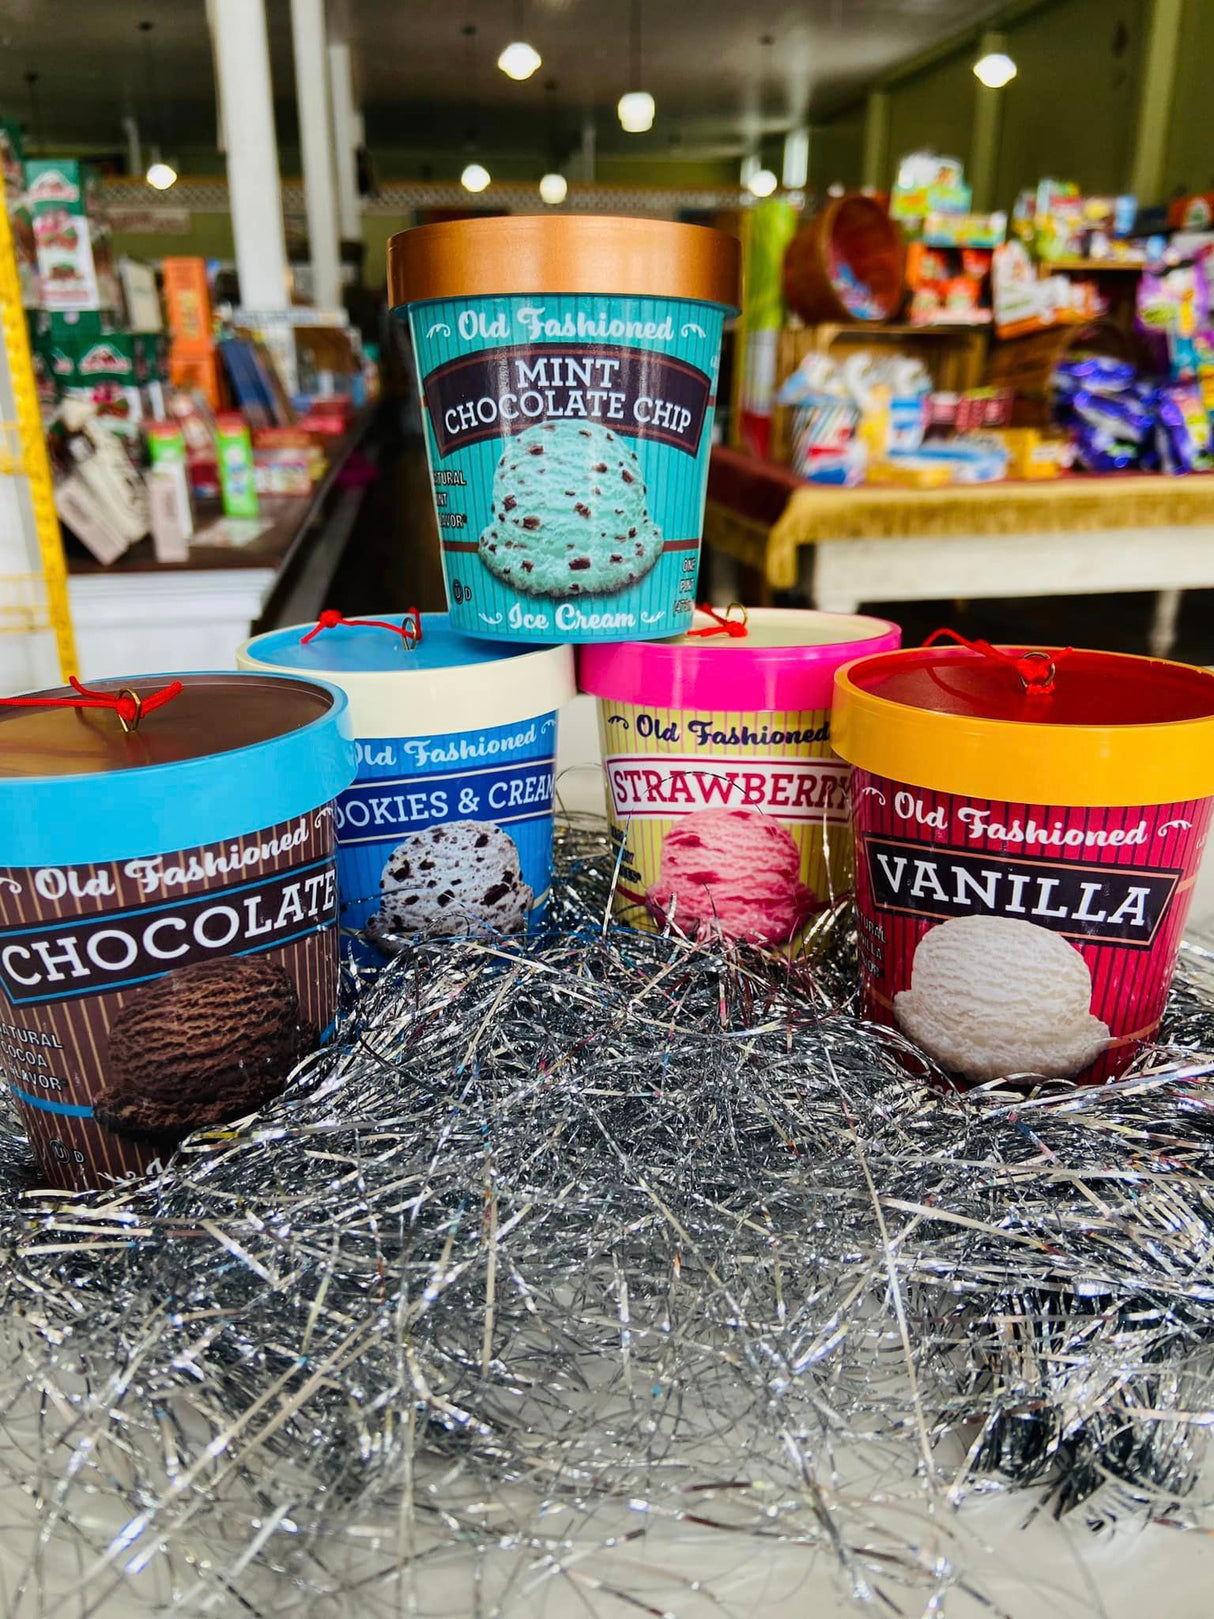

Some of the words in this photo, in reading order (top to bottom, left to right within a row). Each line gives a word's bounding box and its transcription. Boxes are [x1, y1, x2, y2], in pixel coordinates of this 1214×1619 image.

[458, 309, 510, 341] Old
[517, 307, 675, 341] Fashioned
[515, 357, 620, 389] MINT
[444, 390, 627, 435] CHOCOLATE
[632, 396, 692, 434] CHIP
[507, 603, 549, 630] Ice
[555, 602, 637, 630] Cream
[403, 724, 537, 767] Fashioned
[636, 714, 681, 742] Old
[688, 719, 830, 746] Fashioned
[458, 788, 479, 814] &
[894, 791, 949, 830] Old
[957, 806, 1148, 848] Fashioned
[35, 868, 116, 899] Old
[124, 823, 309, 893] Fashioned
[877, 853, 1151, 927] VANILLA
[1, 869, 336, 986] CHOCOLATE
[0, 1022, 63, 1049] ATURAL
